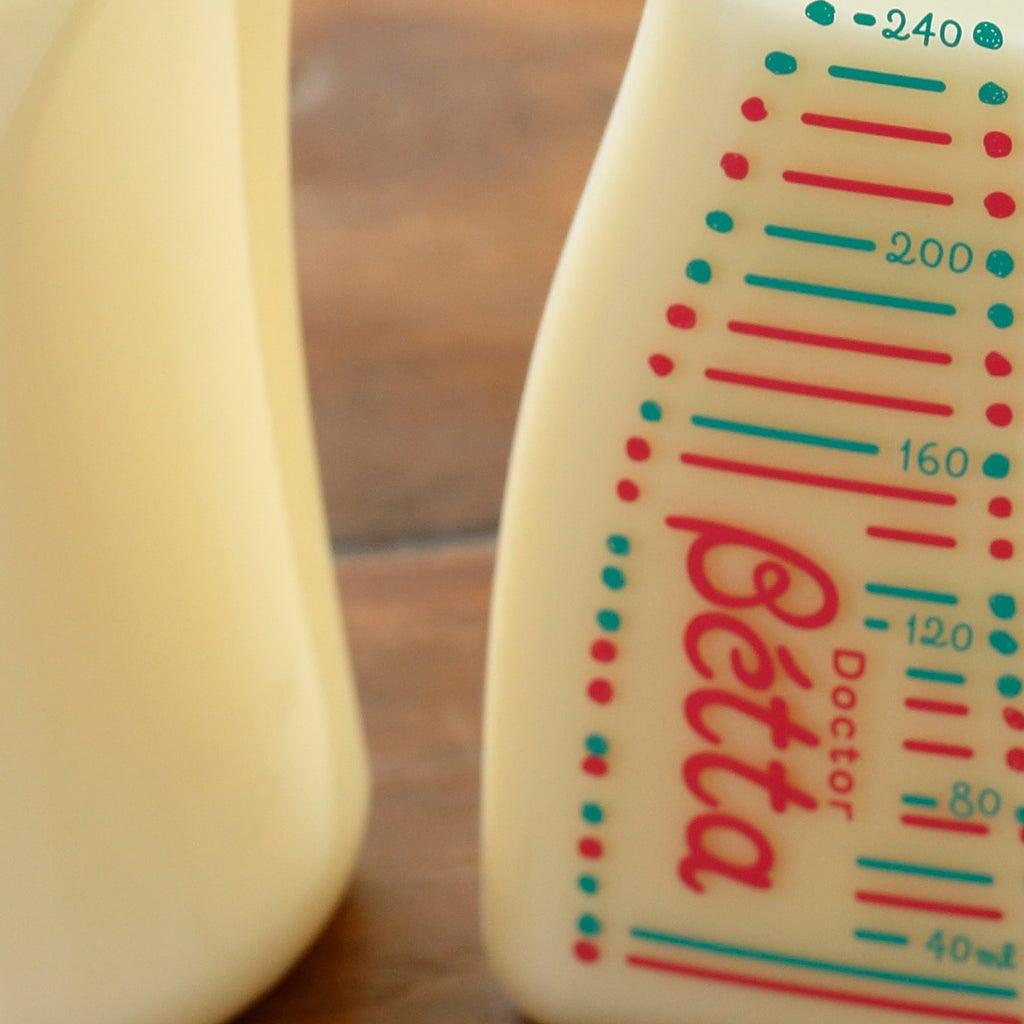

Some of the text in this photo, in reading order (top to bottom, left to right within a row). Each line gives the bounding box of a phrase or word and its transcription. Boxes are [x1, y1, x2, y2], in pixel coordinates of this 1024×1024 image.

[881, 8, 963, 47] 240
[885, 231, 974, 273] 200
[900, 439, 969, 478] 160
[906, 613, 974, 652] 120
[828, 649, 867, 822] Doctor
[948, 781, 1002, 817] 80
